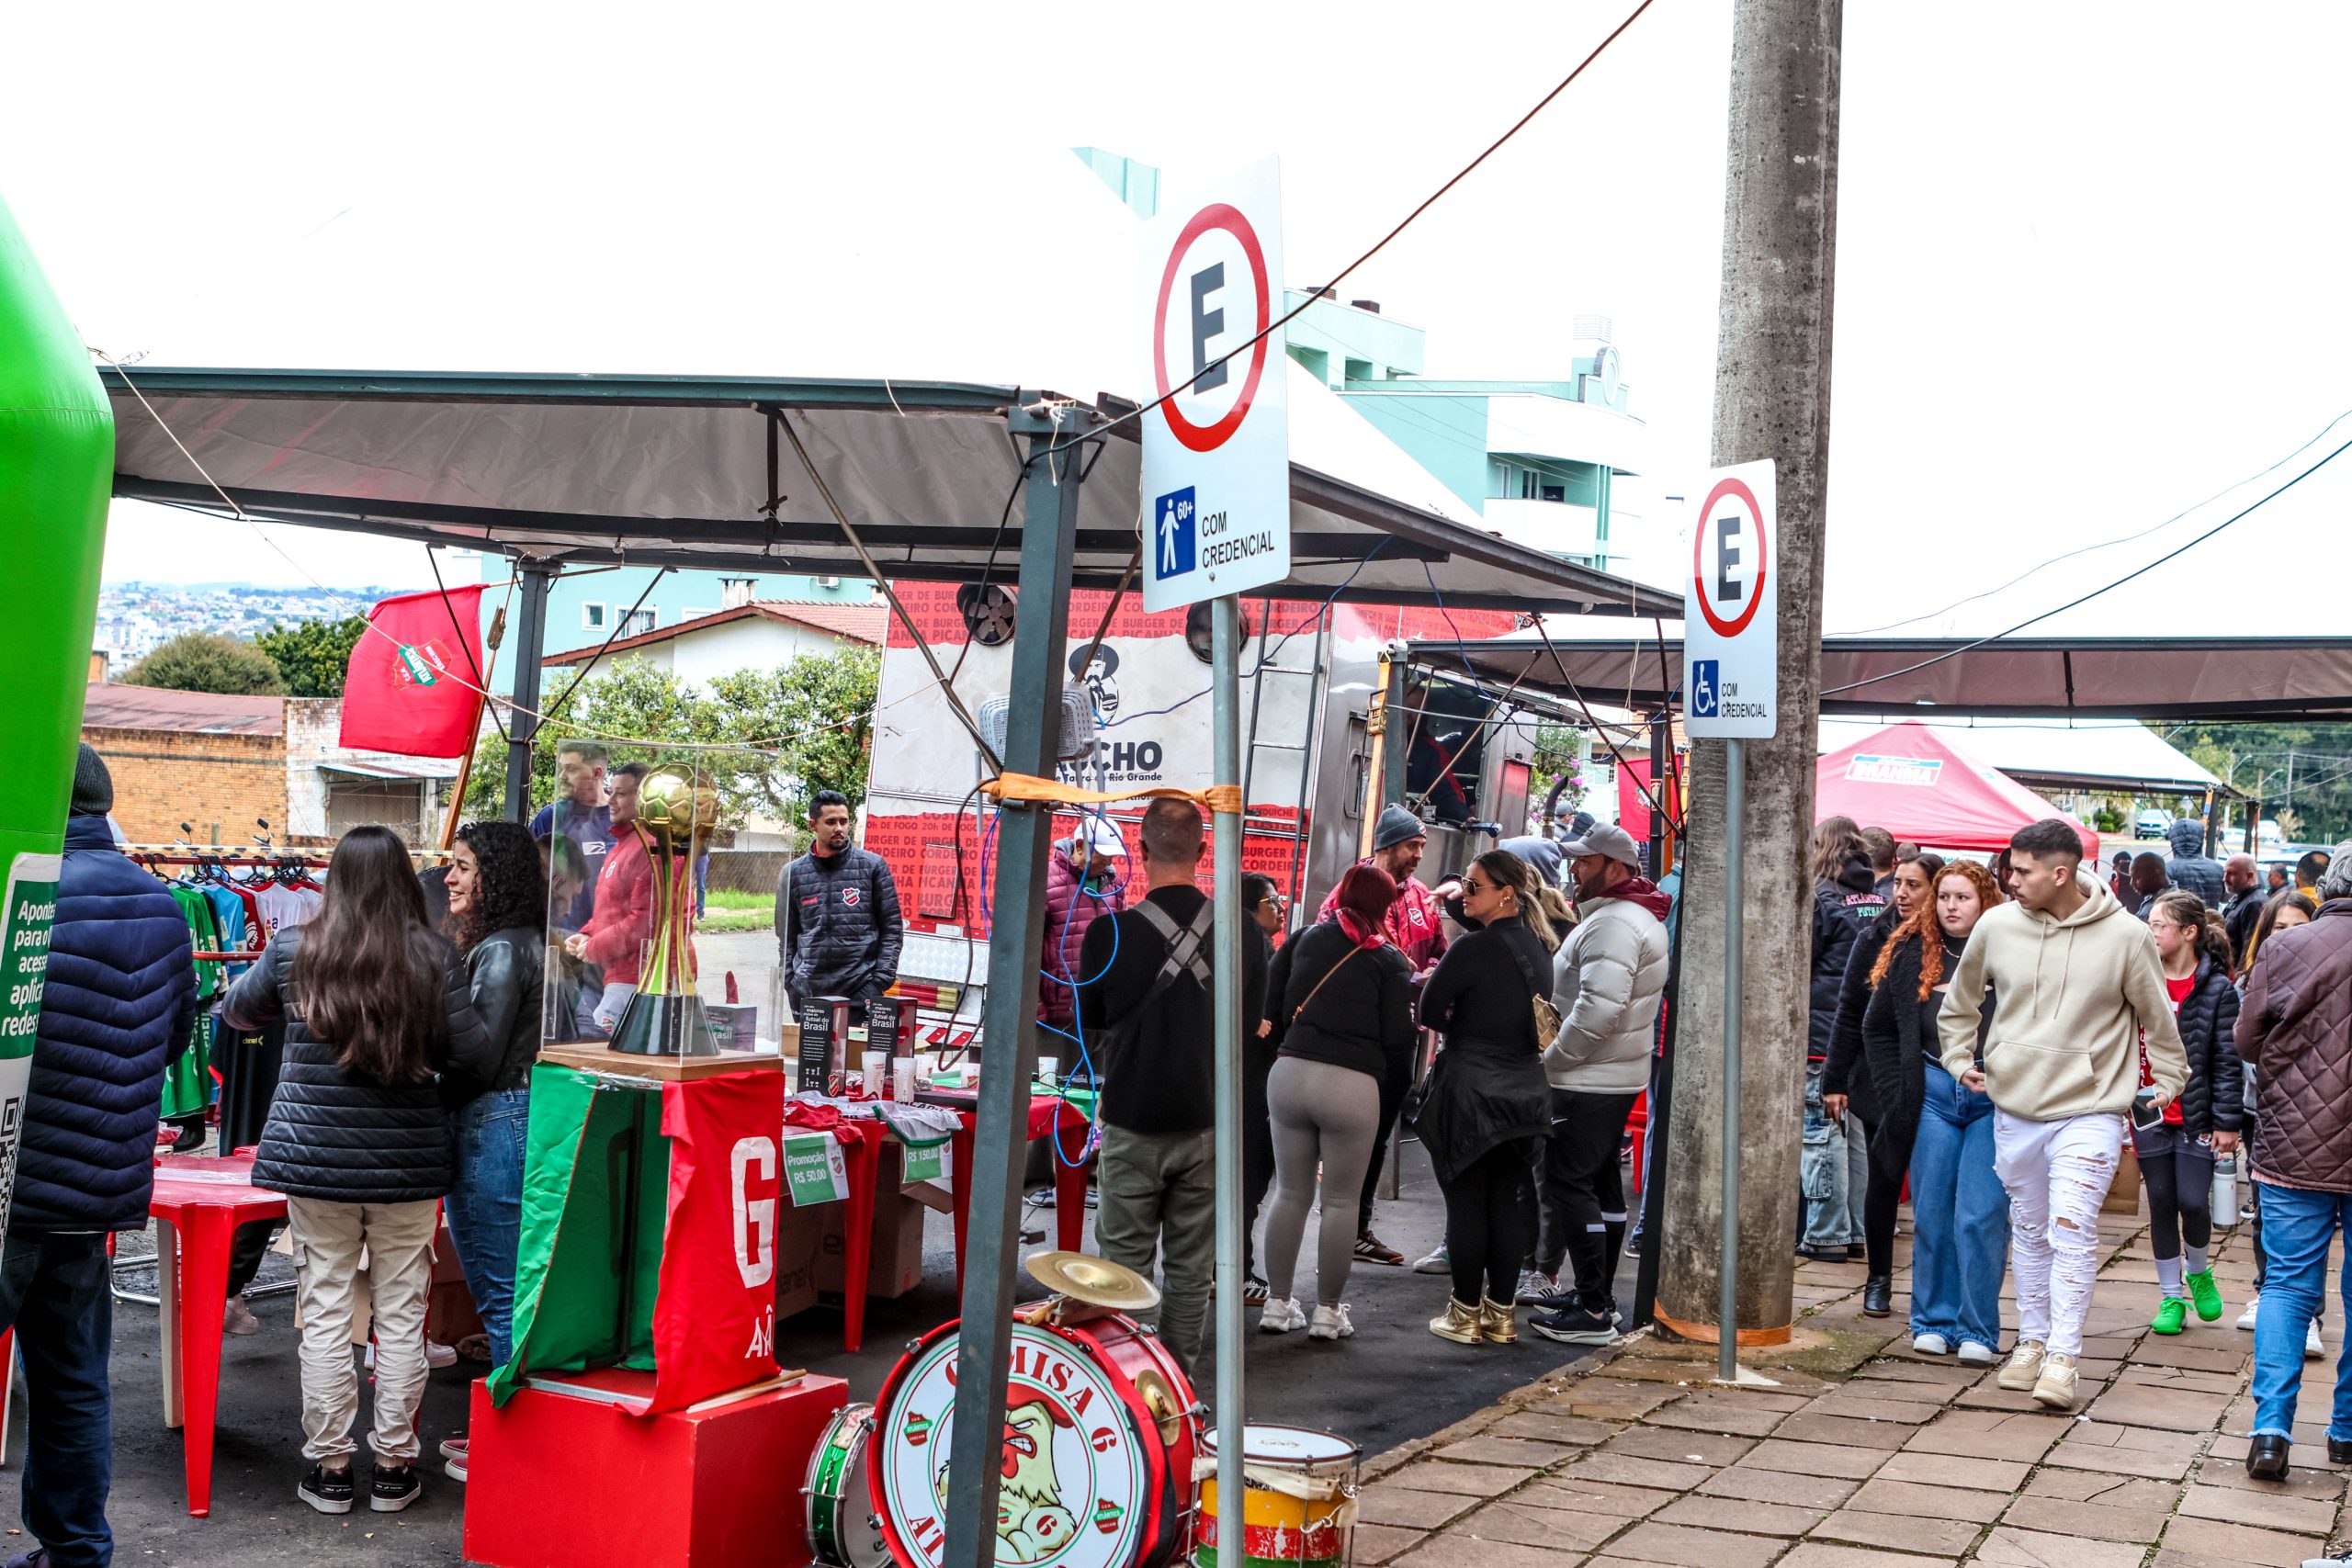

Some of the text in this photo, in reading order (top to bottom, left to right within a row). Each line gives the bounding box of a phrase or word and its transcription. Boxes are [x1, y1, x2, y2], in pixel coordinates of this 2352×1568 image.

[1191, 261, 1228, 395] E
[1177, 500, 1193, 521] 60+
[1202, 511, 1227, 537] COM
[1202, 530, 1275, 569] CREDENCIAL
[1717, 516, 1742, 602] E
[1123, 618, 1162, 629] BURGER
[1721, 682, 1738, 697] COM
[1721, 703, 1768, 718] CREDENCIAL
[1126, 772, 1162, 782] Grande
[894, 822, 918, 830] FOGO
[922, 822, 939, 831] 20h
[903, 836, 917, 846] DE
[1243, 846, 1287, 858] BURGER
[14, 929, 43, 952] para
[803, 1021, 829, 1032] Brasil
[872, 1018, 895, 1029] Brasil
[2138, 1022, 2149, 1088] UTSAL
[787, 1151, 826, 1168] Promoção
[908, 1149, 940, 1164] R$ 150,00
[794, 1169, 827, 1184] R$ 50,00
